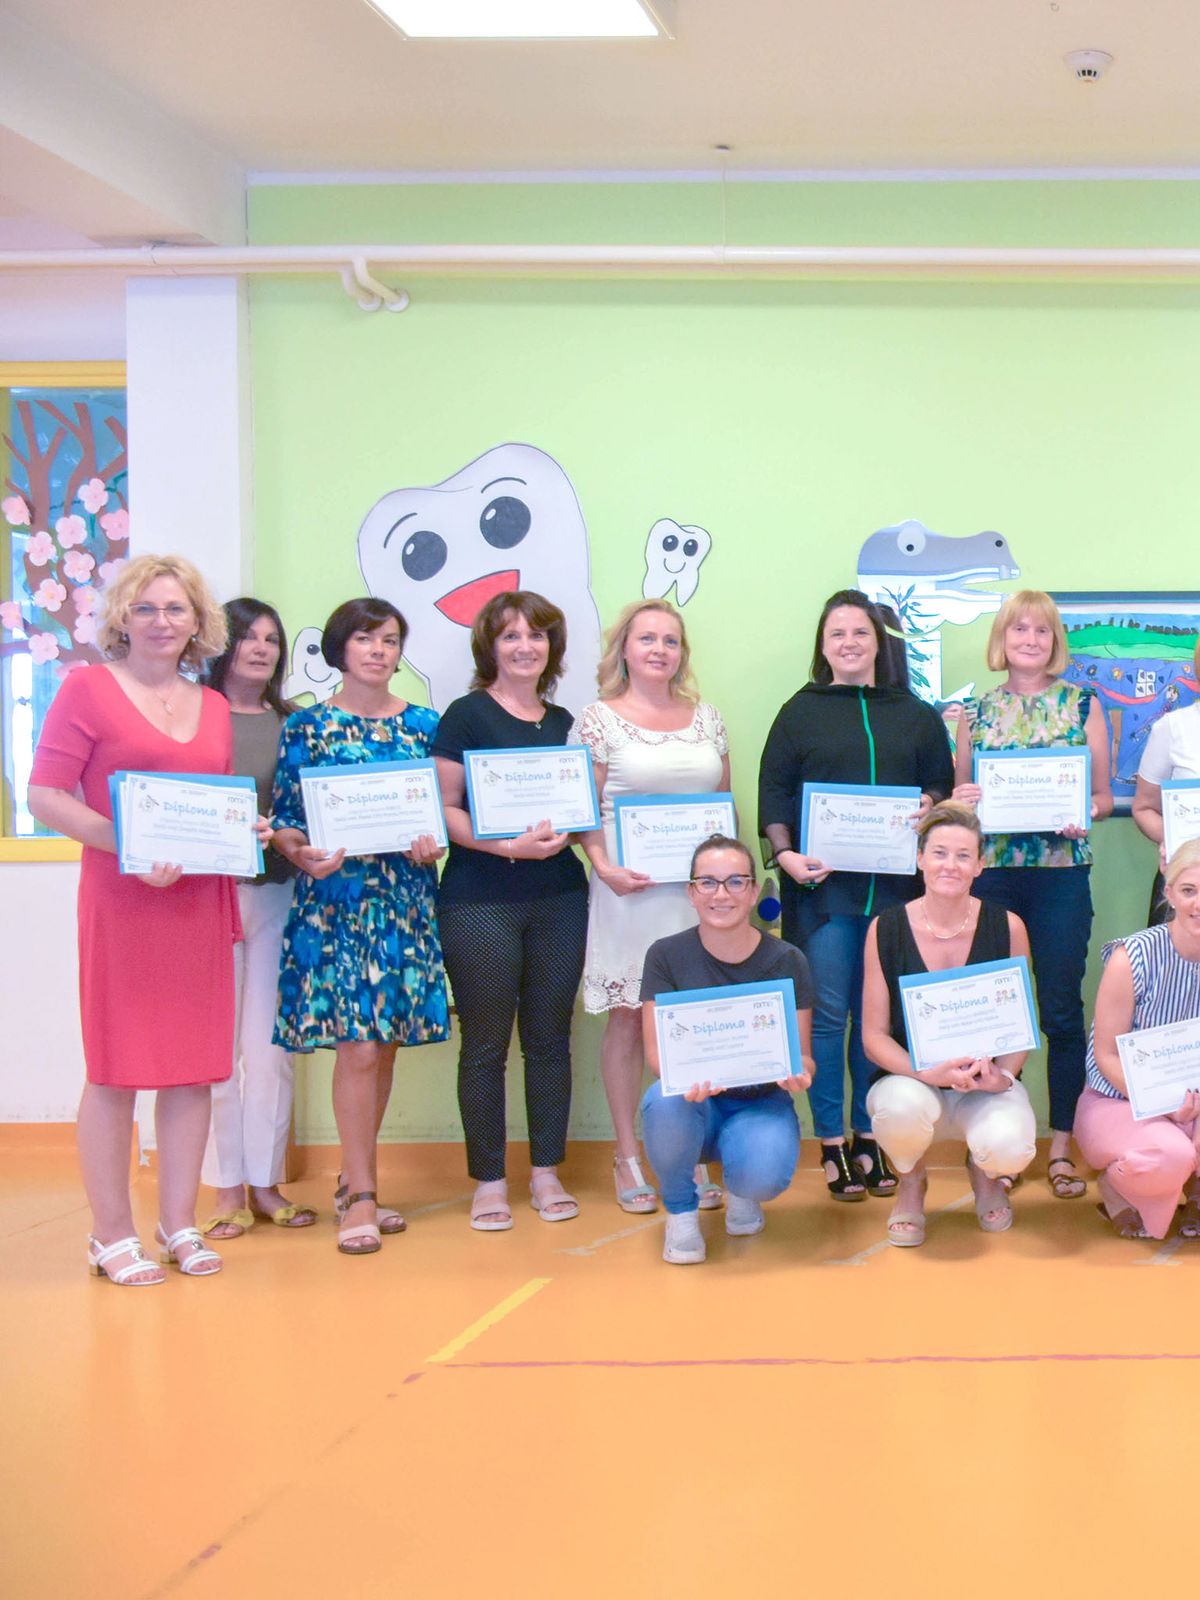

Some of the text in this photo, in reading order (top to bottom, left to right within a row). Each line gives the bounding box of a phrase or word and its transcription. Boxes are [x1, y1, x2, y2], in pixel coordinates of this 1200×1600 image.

[505, 771, 551, 783] Diploma
[1008, 774, 1051, 786] Diploma
[347, 792, 398, 805] Diploma
[163, 800, 217, 816] Diploma
[840, 813, 885, 825] Diploma
[652, 823, 697, 835] Diploma
[940, 995, 989, 1013] Diploma
[693, 1019, 745, 1037] Diploma
[1153, 1040, 1200, 1059] Diploma
